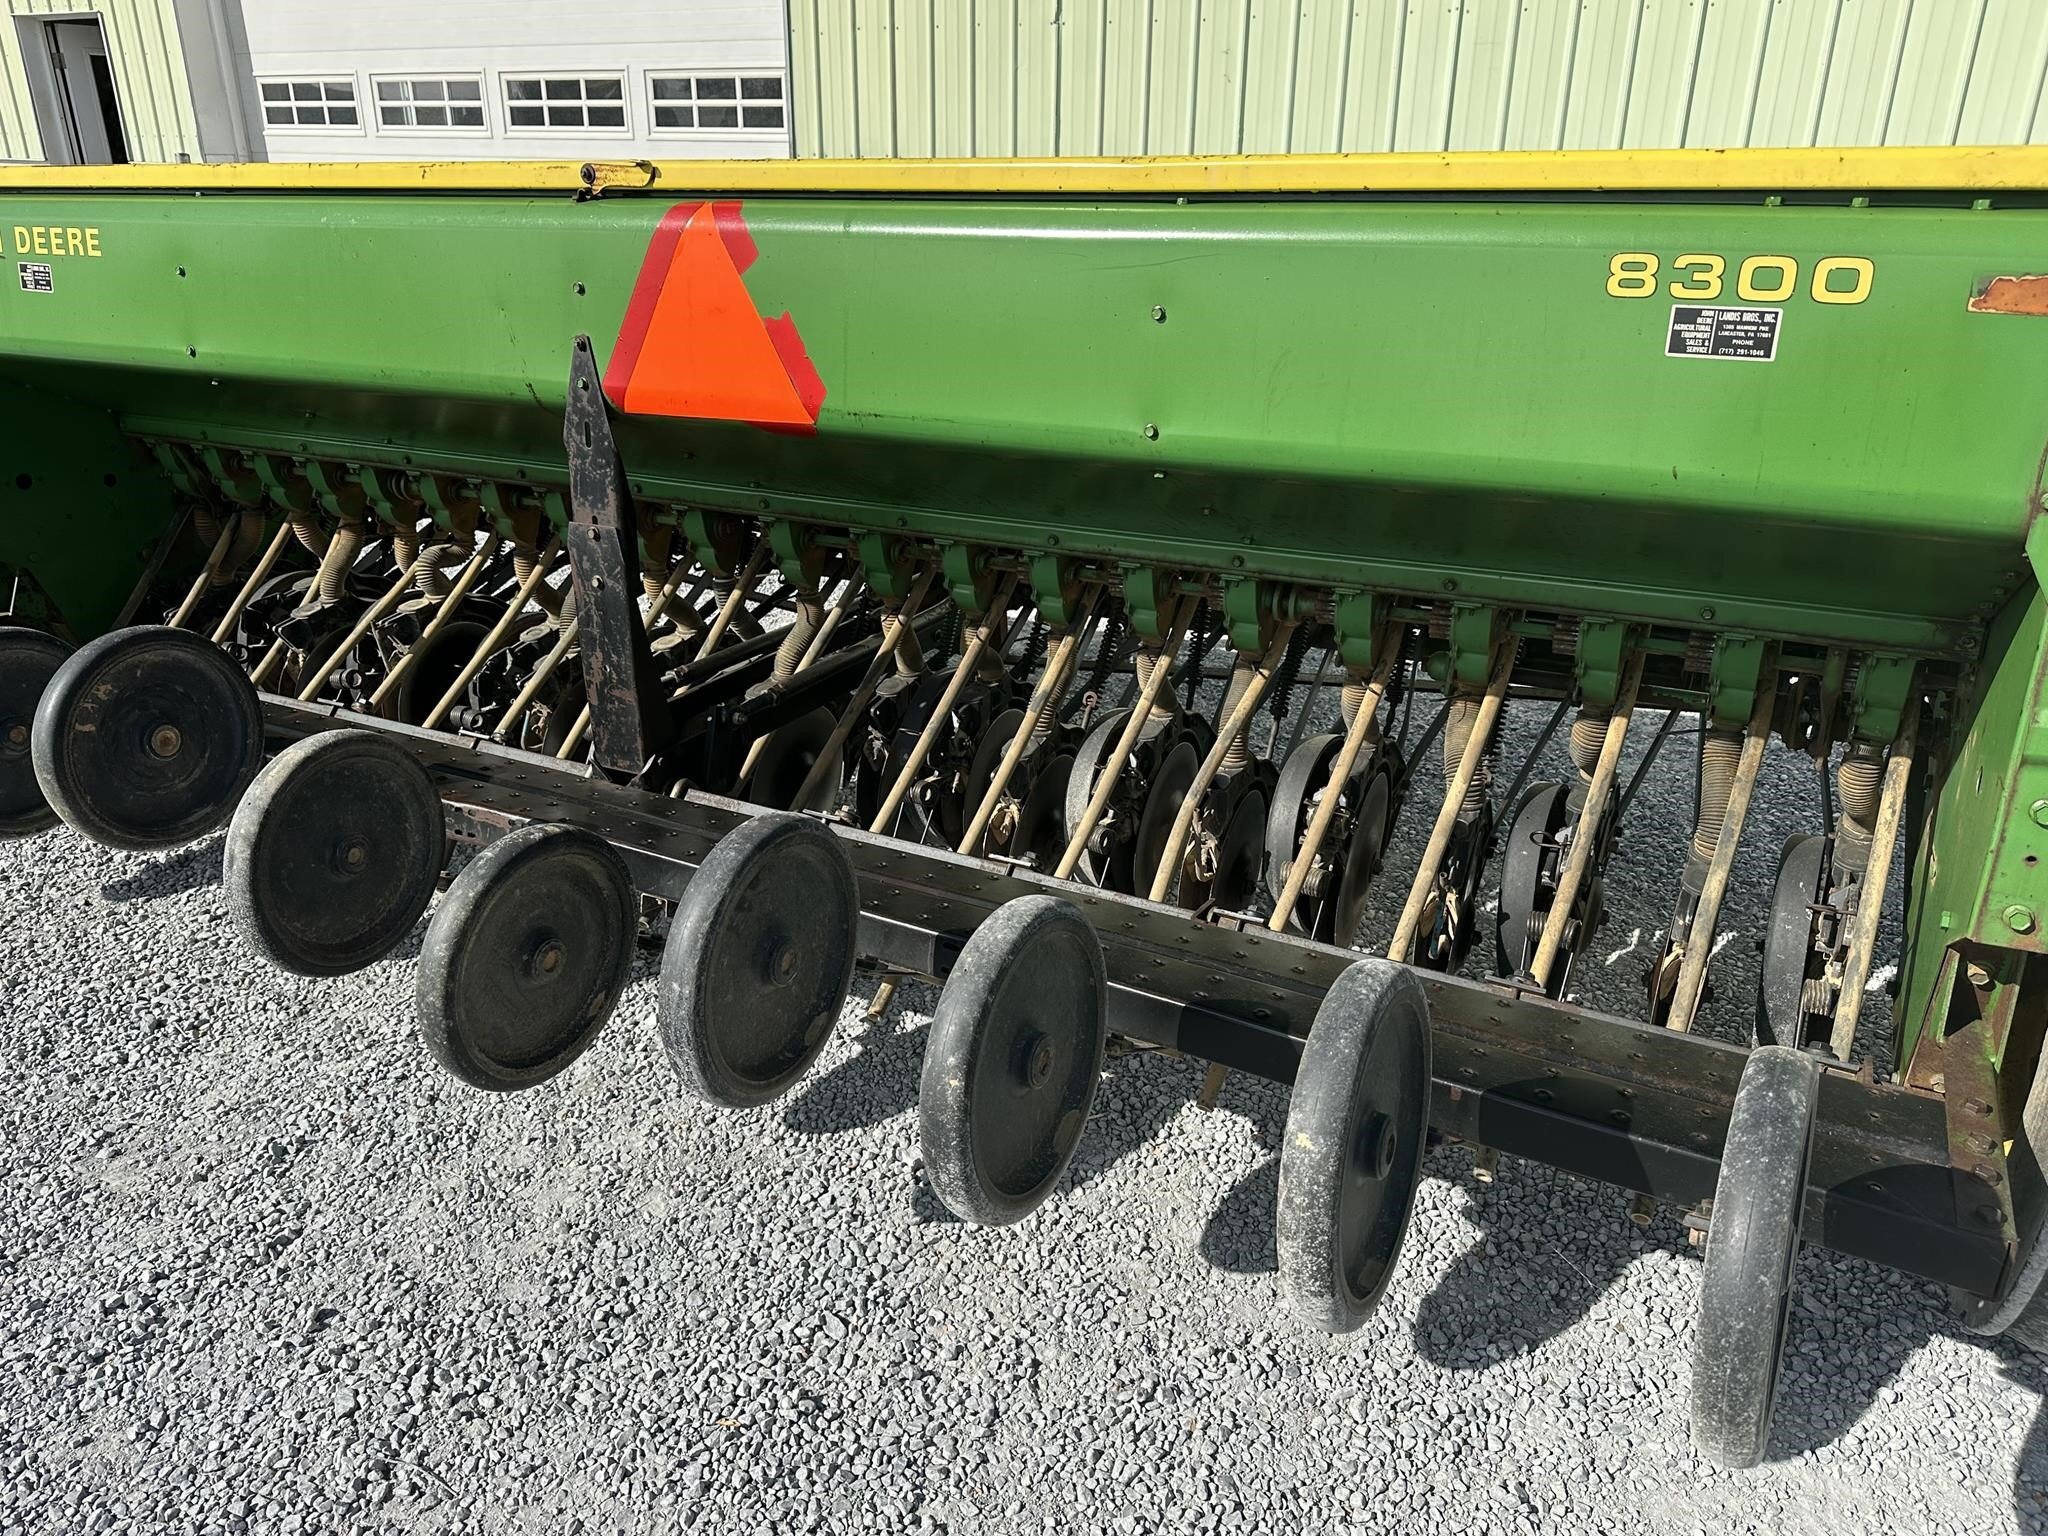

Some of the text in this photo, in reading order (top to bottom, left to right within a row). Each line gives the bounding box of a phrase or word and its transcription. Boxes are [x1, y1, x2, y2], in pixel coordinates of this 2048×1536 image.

[13, 225, 102, 257] DEERE
[1605, 252, 1875, 304] 8300
[1719, 311, 1742, 321] LANDIS
[1673, 323, 1711, 331] AGRICULTURAL
[1681, 331, 1711, 339] EQUIPMENT
[1685, 338, 1702, 346] SALES
[1686, 346, 1708, 354] SERVICE
[1718, 347, 1734, 355] (717)
